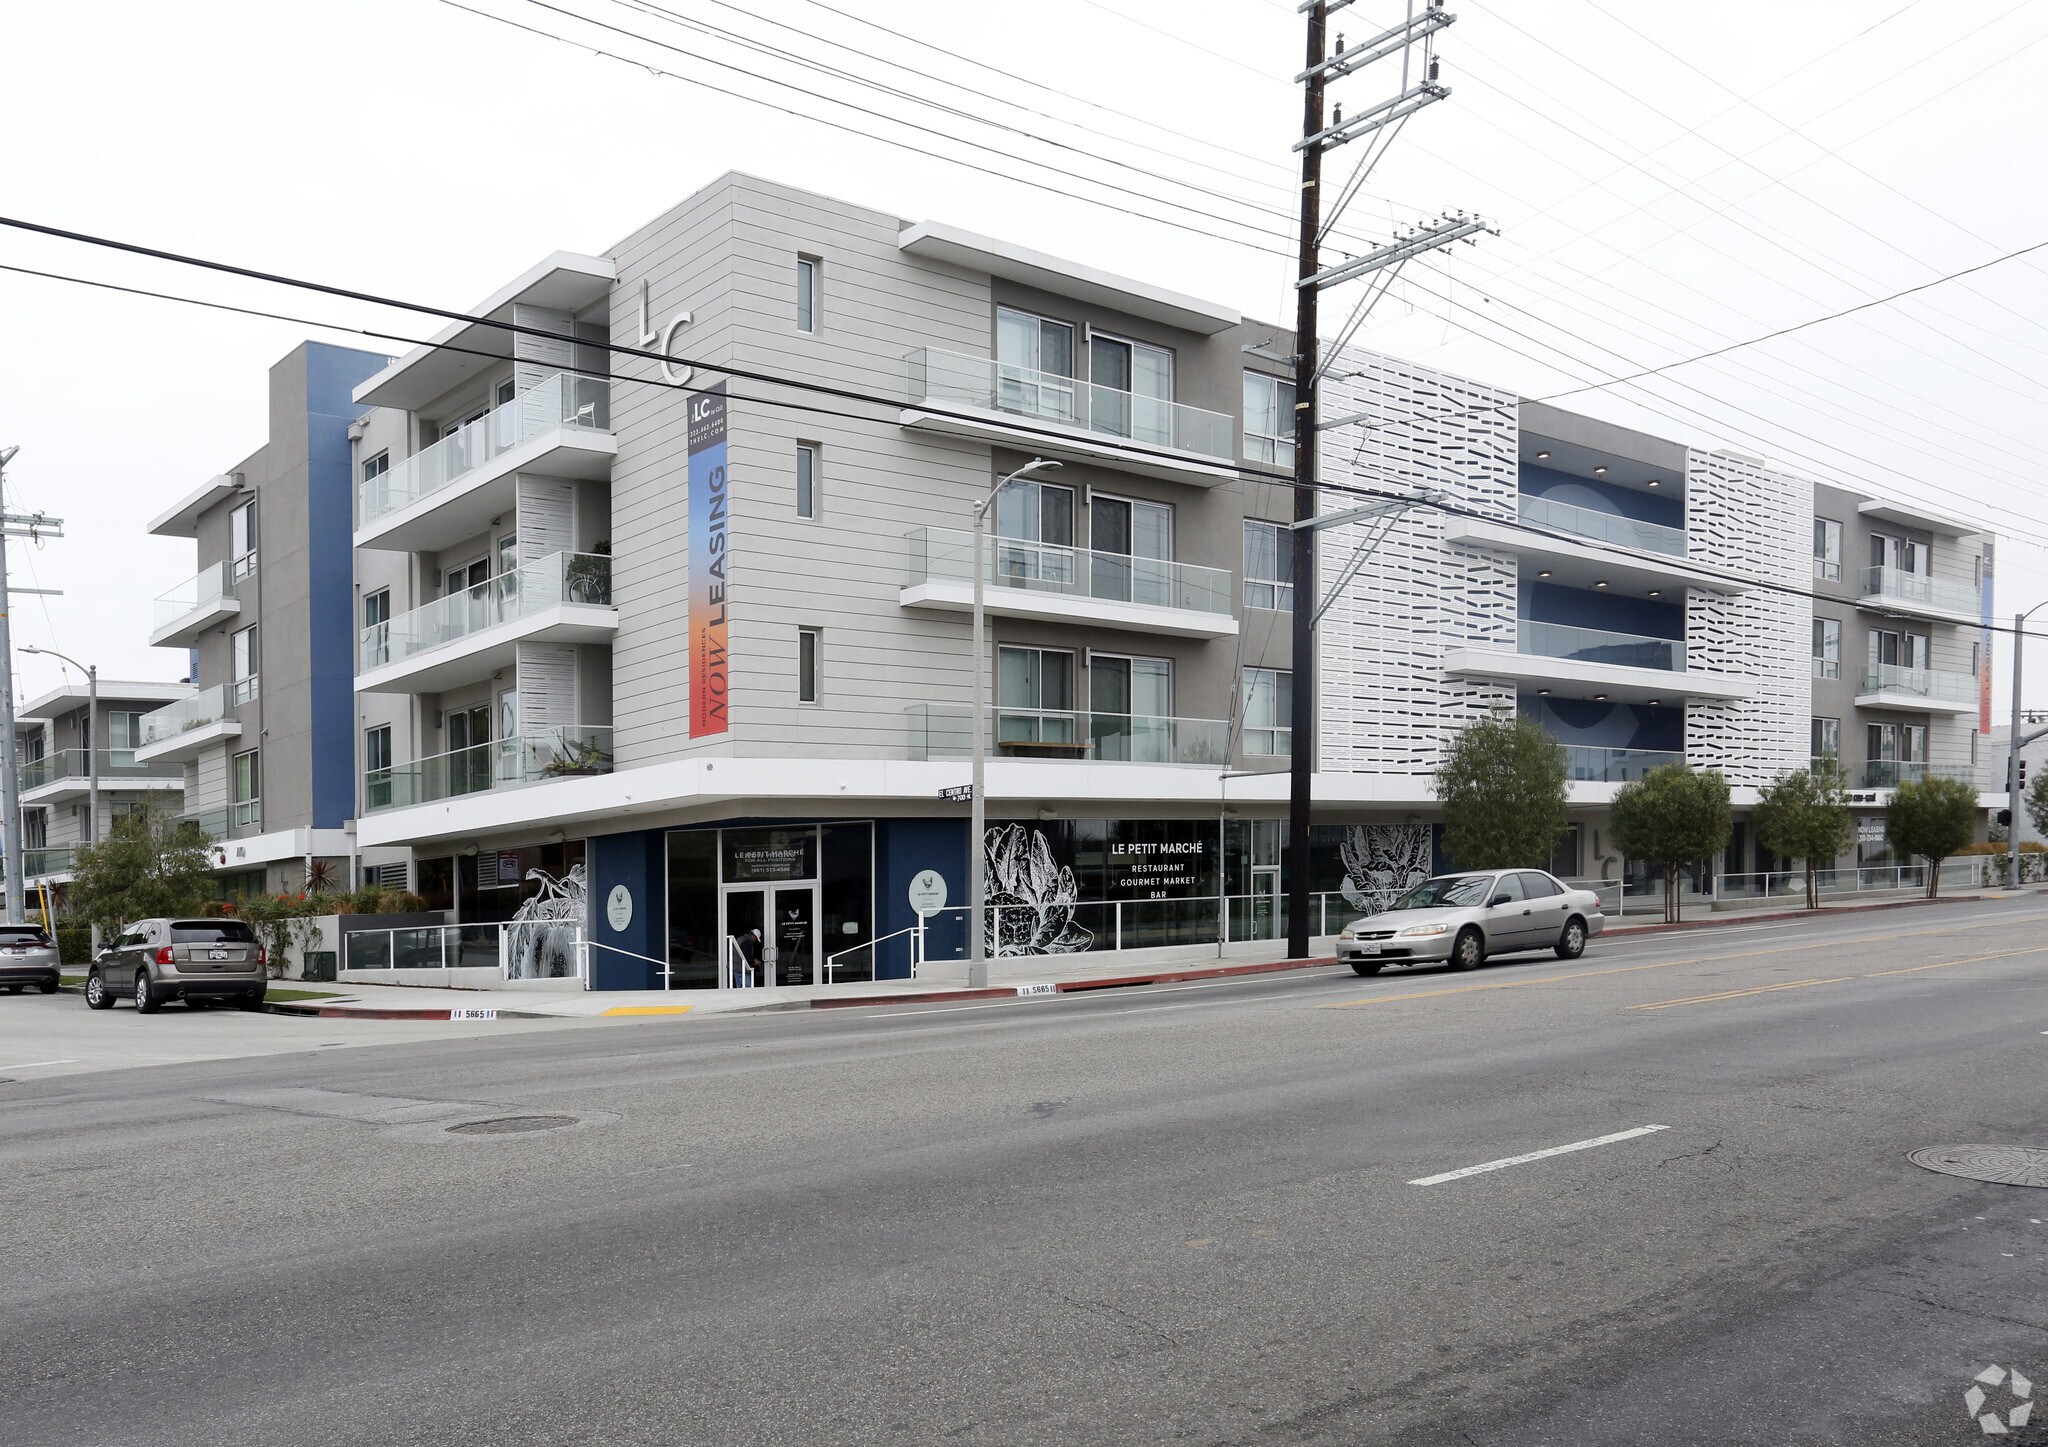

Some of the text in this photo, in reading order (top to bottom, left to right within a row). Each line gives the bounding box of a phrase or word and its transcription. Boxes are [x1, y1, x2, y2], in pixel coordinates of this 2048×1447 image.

[694, 398, 710, 422] LC
[690, 426, 724, 445] THELC.COM
[708, 464, 726, 721] NOW LEASING
[938, 790, 945, 798] EL
[946, 787, 962, 797] CENTRO
[957, 794, 966, 803] 700
[1869, 825, 1885, 833] LEASING
[1112, 840, 1203, 855] LE PETIT MARCHÉ
[1131, 863, 1184, 872] RESTAURANT
[1120, 876, 1195, 887] GOURMET MARKET
[1150, 891, 1167, 899] BAR
[465, 1010, 485, 1018] 5665
